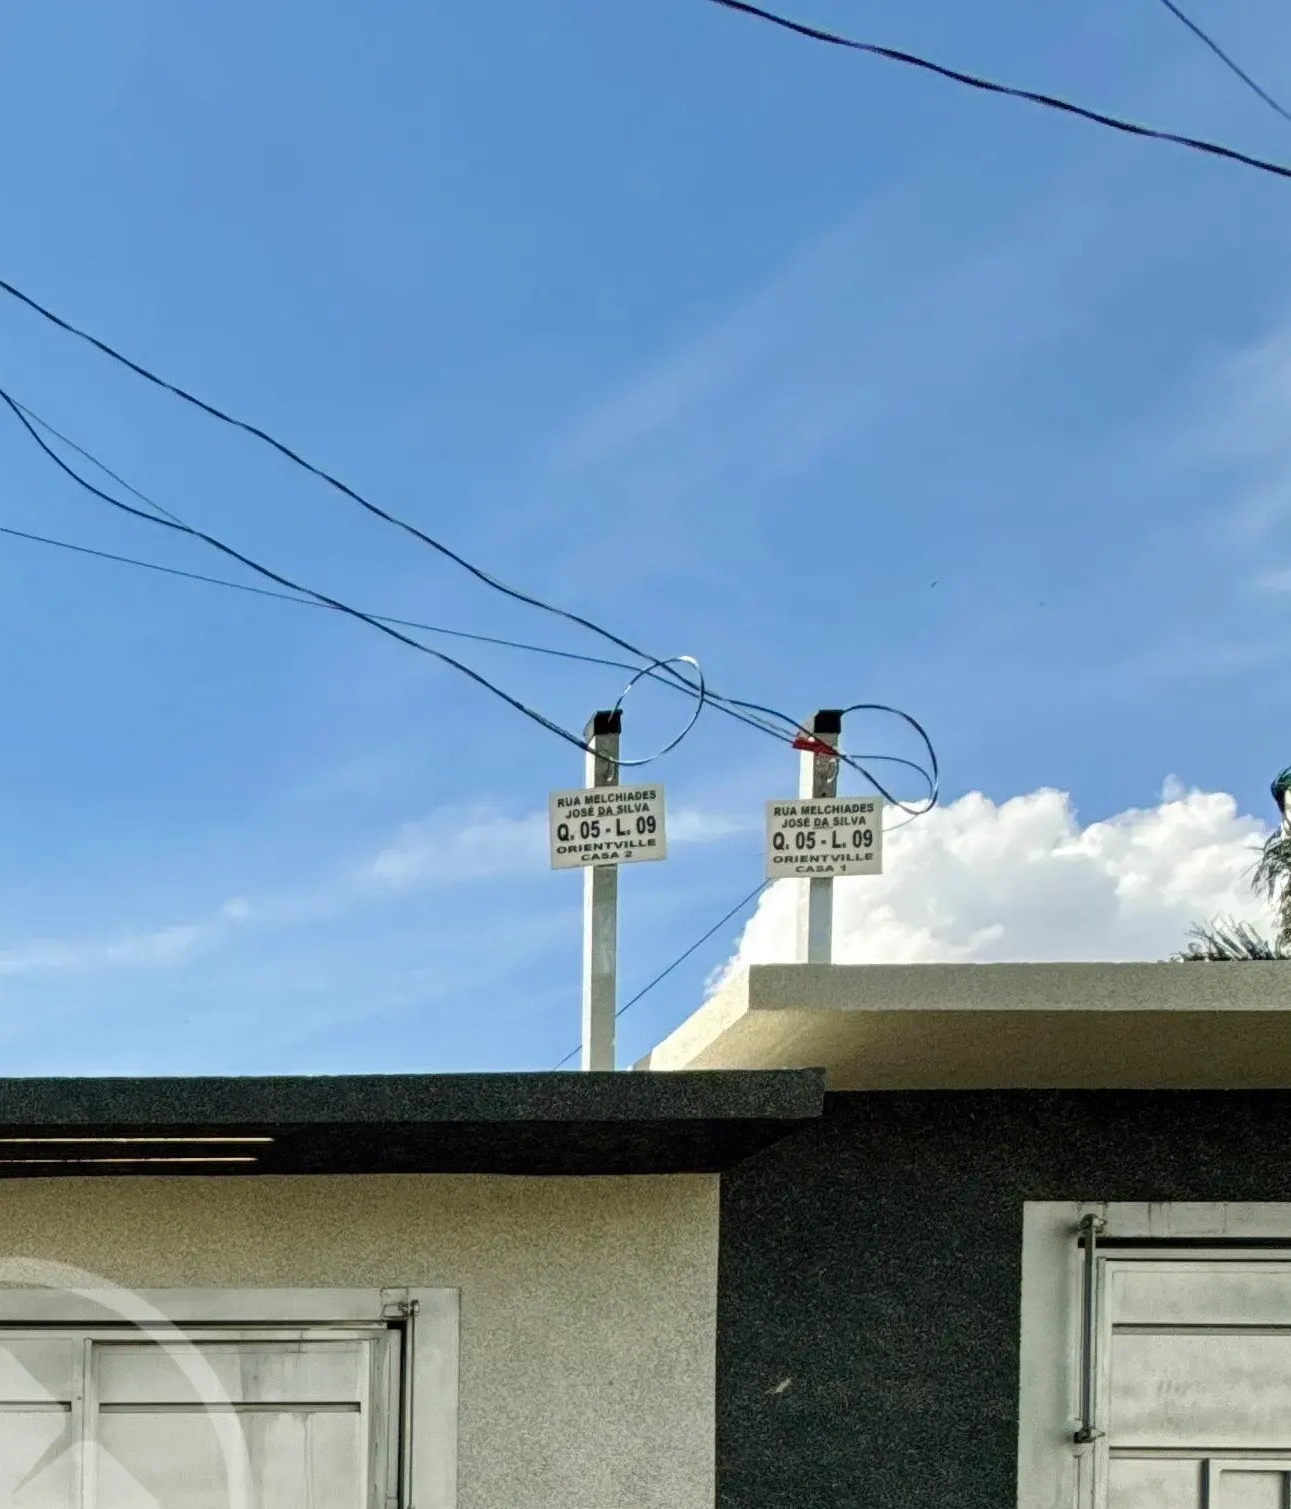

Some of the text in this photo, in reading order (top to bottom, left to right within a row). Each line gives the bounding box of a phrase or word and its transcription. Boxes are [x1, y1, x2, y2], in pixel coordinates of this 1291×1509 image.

[557, 790, 657, 808] RUA MELCHIADES
[597, 806, 614, 817] DA
[617, 803, 650, 814] SILVA
[774, 803, 874, 816] RUA MELCHIADES
[814, 817, 829, 827] DA
[833, 816, 866, 826] SILVA
[557, 823, 575, 842] Q.
[580, 820, 600, 839] 05
[616, 818, 631, 836] L.
[636, 815, 656, 834] 09
[773, 831, 790, 850] Q.
[795, 831, 816, 849] 05
[832, 830, 847, 848] L.
[852, 829, 873, 848] 09
[556, 839, 656, 854] ORIENTVILLE
[581, 850, 633, 861] CASA 2
[773, 852, 874, 864] ORIENTVILLE
[795, 865, 834, 873] CASA
